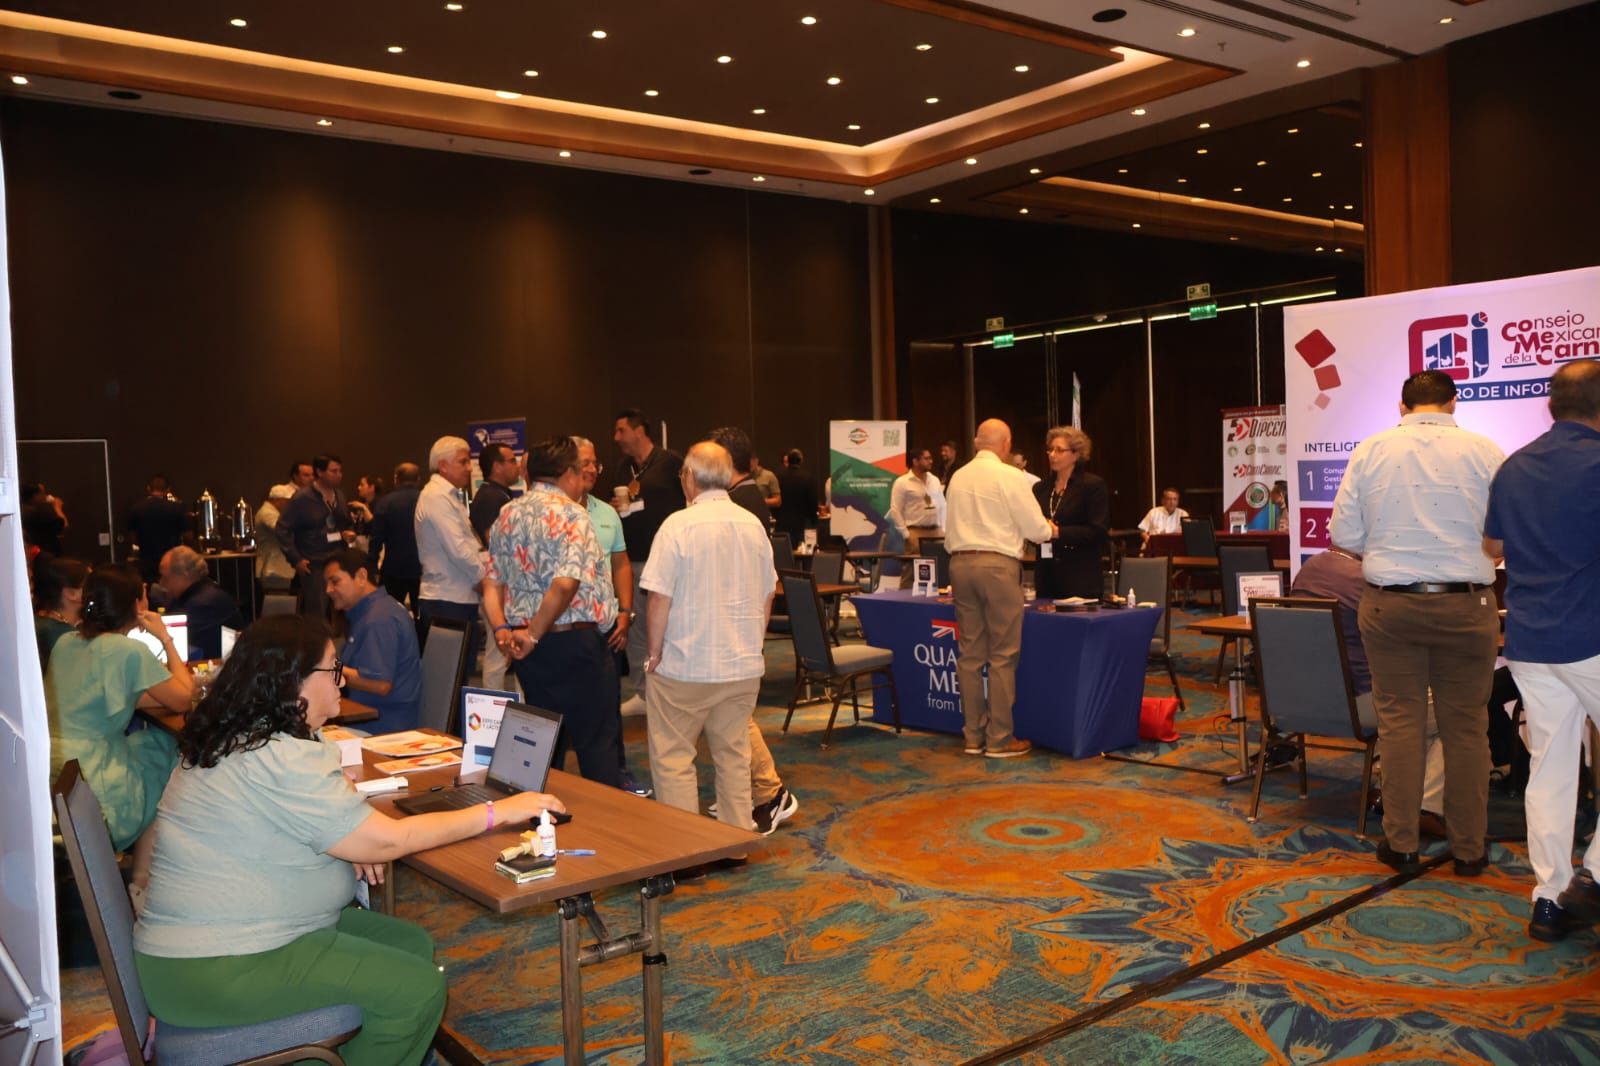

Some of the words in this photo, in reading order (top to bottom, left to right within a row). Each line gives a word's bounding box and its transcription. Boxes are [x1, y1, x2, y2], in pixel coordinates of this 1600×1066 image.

[1501, 310, 1585, 341] Consejo
[1504, 353, 1520, 364] de
[1521, 353, 1532, 362] la
[1536, 340, 1600, 365] Carn
[1479, 386, 1500, 398] DE
[1306, 470, 1315, 491] 1
[1305, 518, 1317, 538] 2
[914, 643, 958, 667] QUA
[929, 668, 960, 695] ME
[927, 692, 955, 712] from
